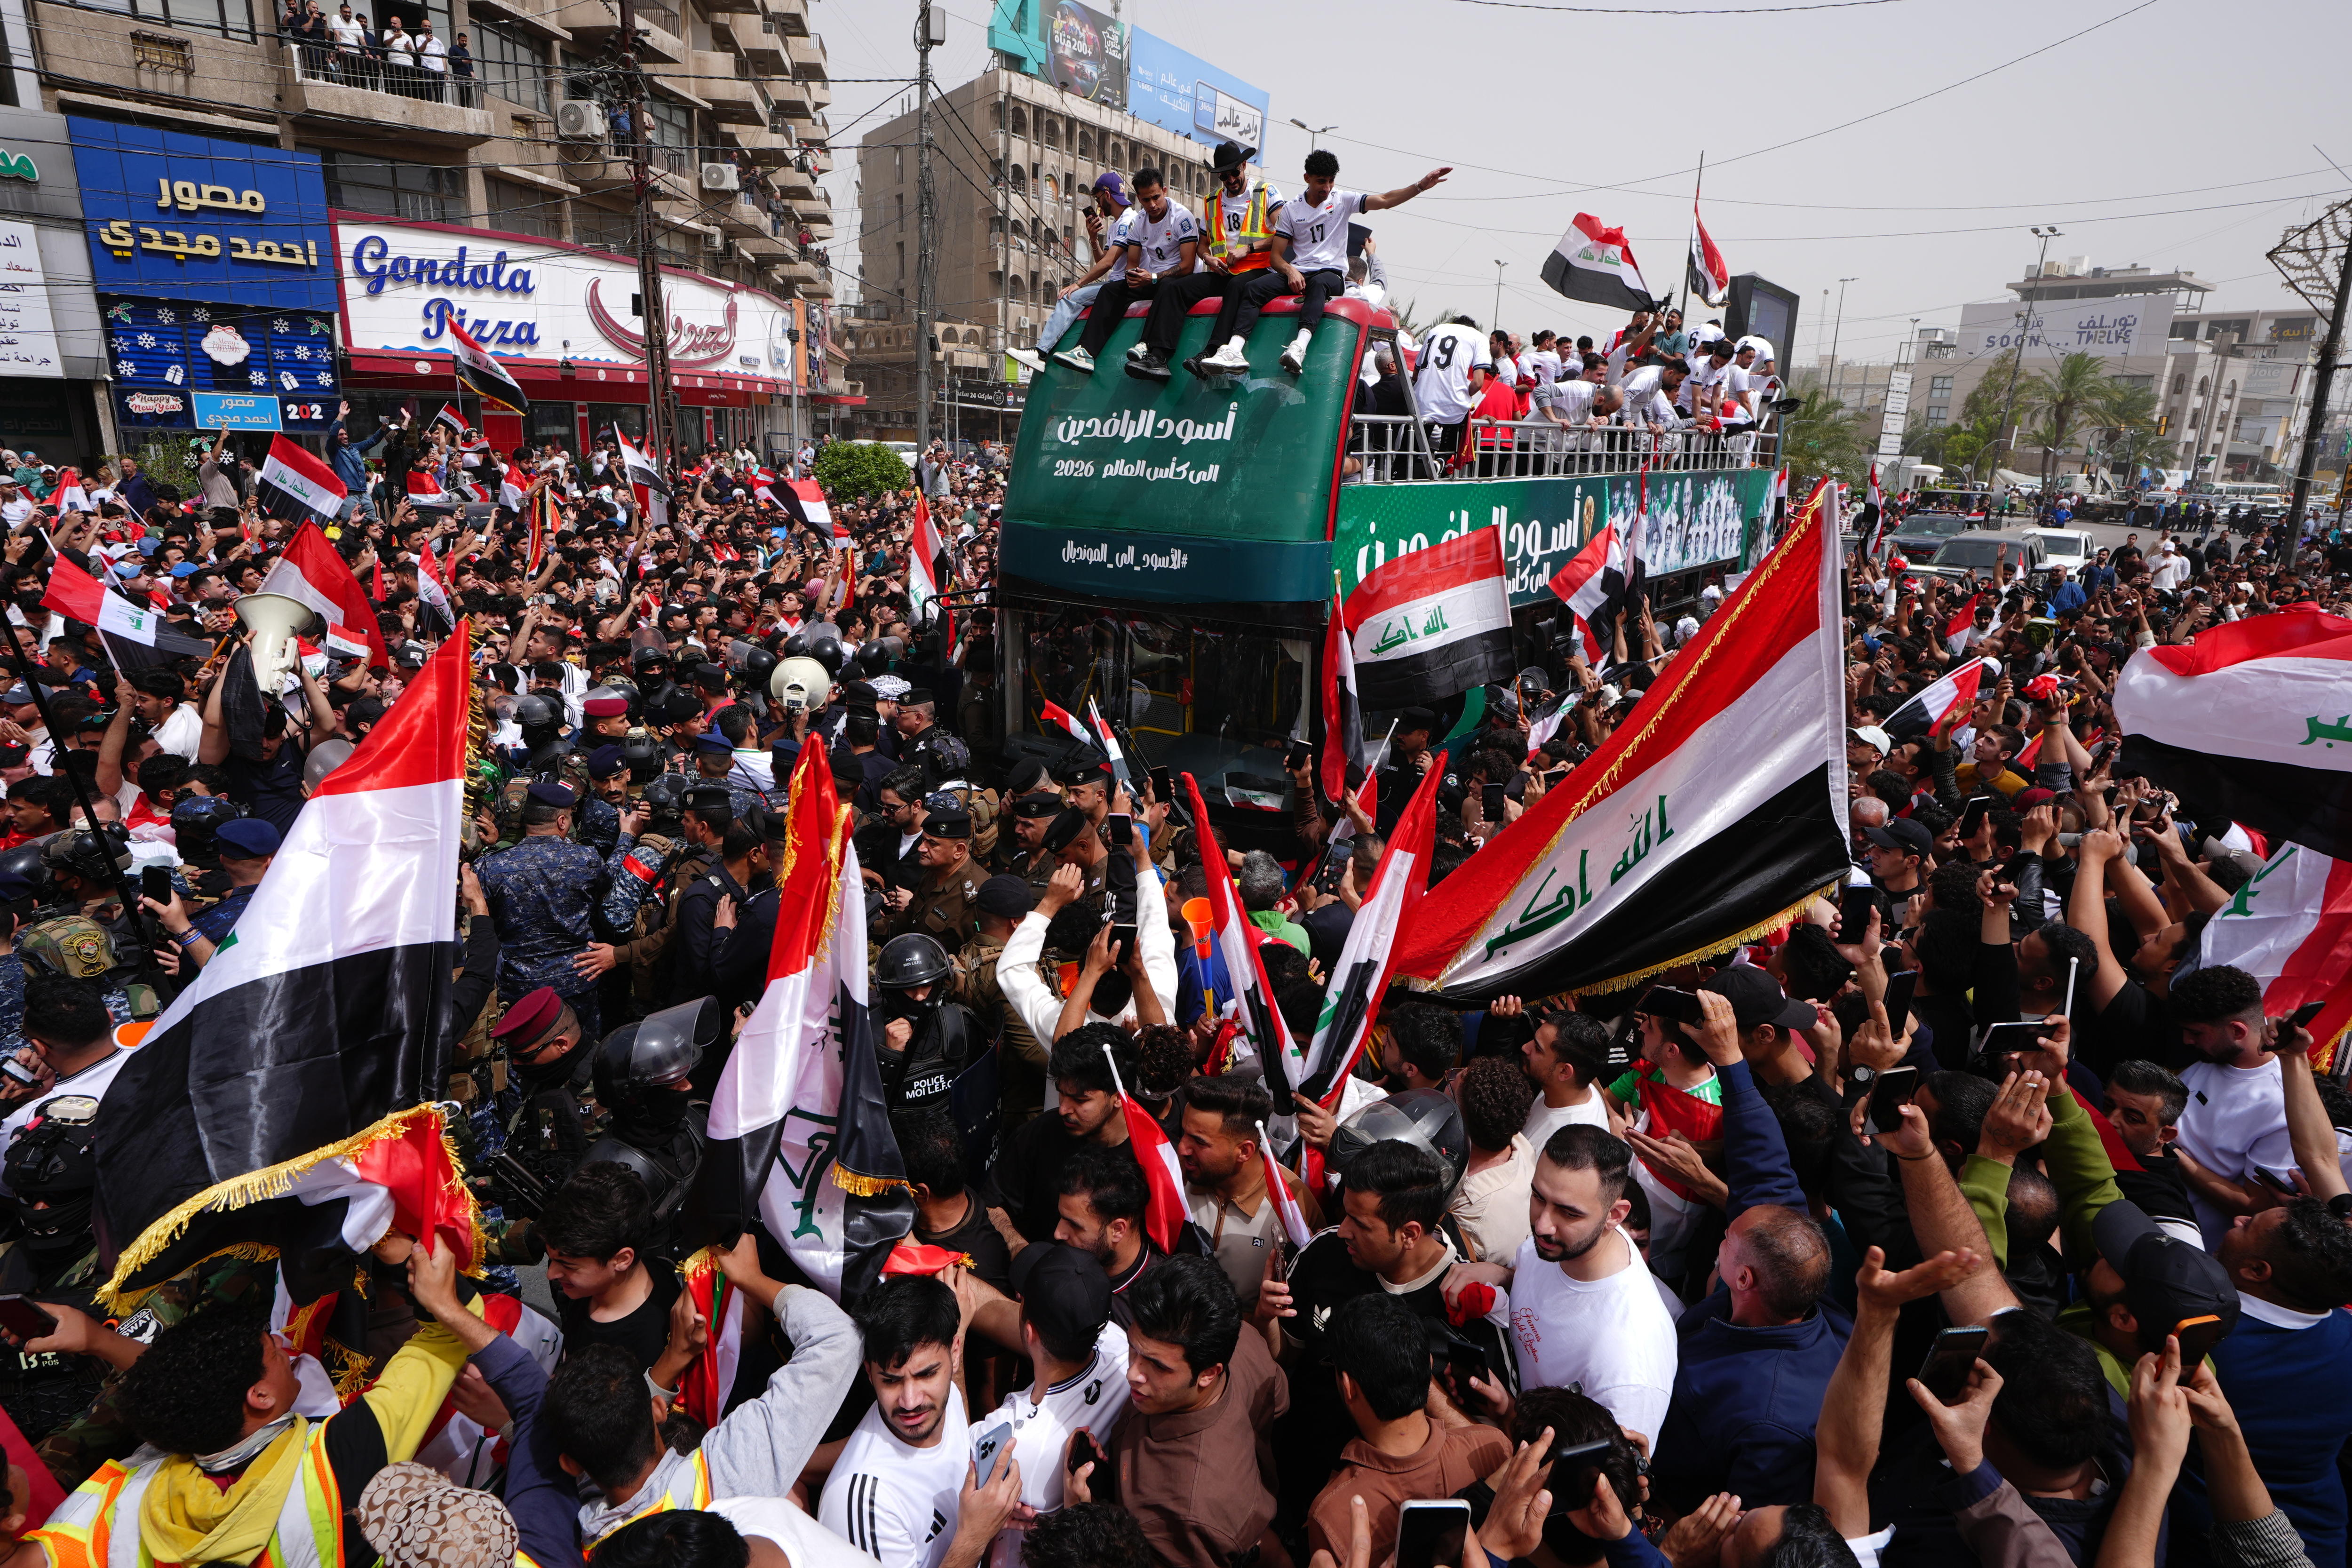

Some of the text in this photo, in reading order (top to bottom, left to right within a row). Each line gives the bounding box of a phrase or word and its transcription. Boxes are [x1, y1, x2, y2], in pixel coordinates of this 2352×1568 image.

[1054, 30, 1071, 48] قناة
[1160, 72, 1191, 96] في عالم
[1160, 91, 1190, 113] التكييف
[1217, 103, 1258, 141] واحد عالم
[157, 178, 265, 213] مصور
[1226, 213, 1240, 232] 18
[99, 220, 318, 266] احمد مجدي
[1310, 223, 1324, 244] 17
[1155, 247, 1164, 260] 8
[353, 235, 535, 294] Gondola
[422, 297, 540, 346] Pizza
[213, 343, 240, 353] CHRISTMAS
[218, 336, 236, 349] Merry
[1688, 331, 1699, 350] 6
[15, 352, 51, 366] جراحة
[1421, 334, 1460, 371] 19
[131, 402, 182, 413] New Year
[140, 395, 170, 405] Happy
[220, 398, 255, 409] مصور
[206, 413, 272, 425] أحمد مجدي
[286, 404, 323, 419] 202
[1057, 402, 1238, 445] أسود الرافدين
[1054, 458, 1220, 484] الى كأس العالم 2026
[1507, 485, 1582, 567] أسود
[1529, 561, 1550, 594] الى
[1369, 605, 1449, 657] الله اكبر
[1480, 795, 1674, 963] الله اكبر
[906, 1079, 953, 1099] MOI L.E.F.C
[914, 1075, 945, 1090] POLICE
[121, 1313, 151, 1337] SWAT
[1510, 1311, 1526, 1332] Bold
[1519, 1307, 1542, 1342] Famous
